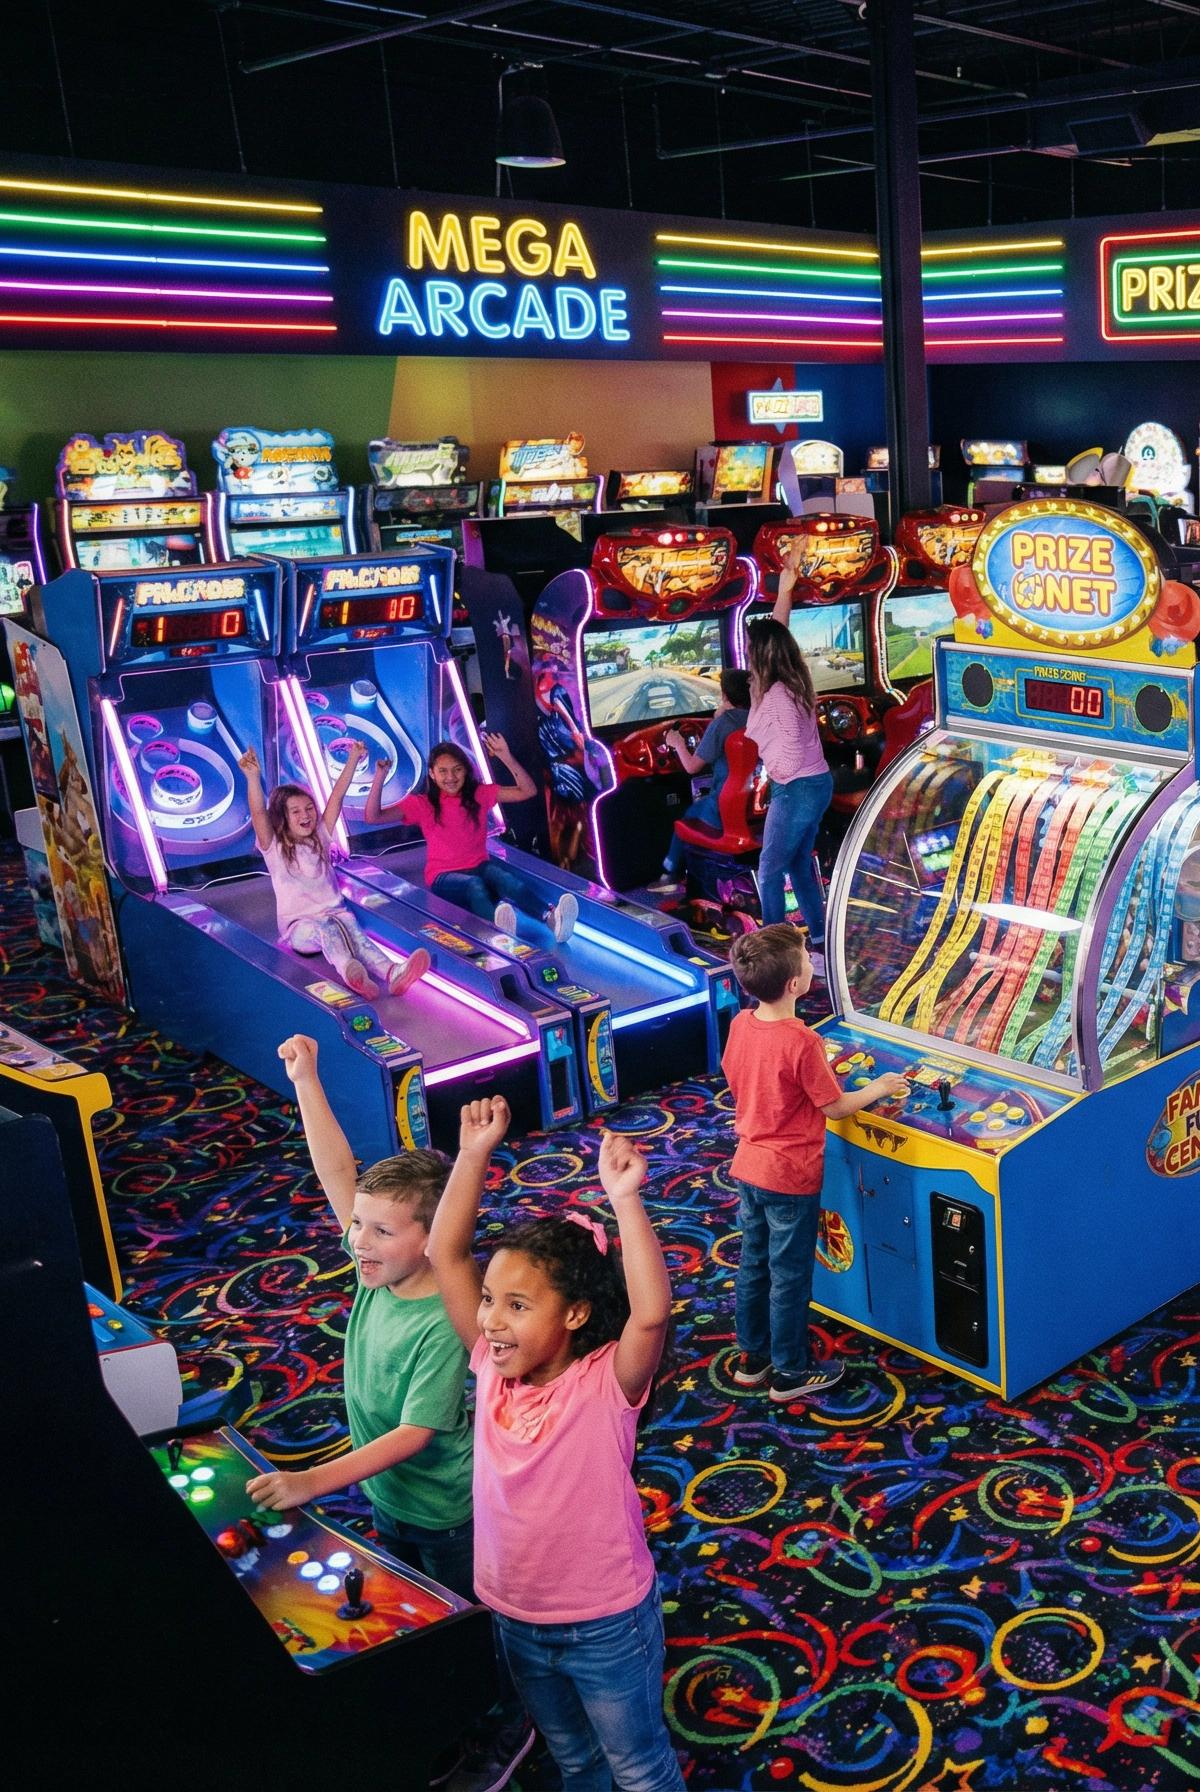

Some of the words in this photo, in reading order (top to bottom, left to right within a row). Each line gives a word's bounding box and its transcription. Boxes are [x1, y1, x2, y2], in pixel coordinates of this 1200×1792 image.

[408, 210, 597, 280] MEGA
[378, 277, 631, 342] ARCADE
[1011, 532, 1115, 577] PRIZE
[1070, 686, 1102, 716] 00
